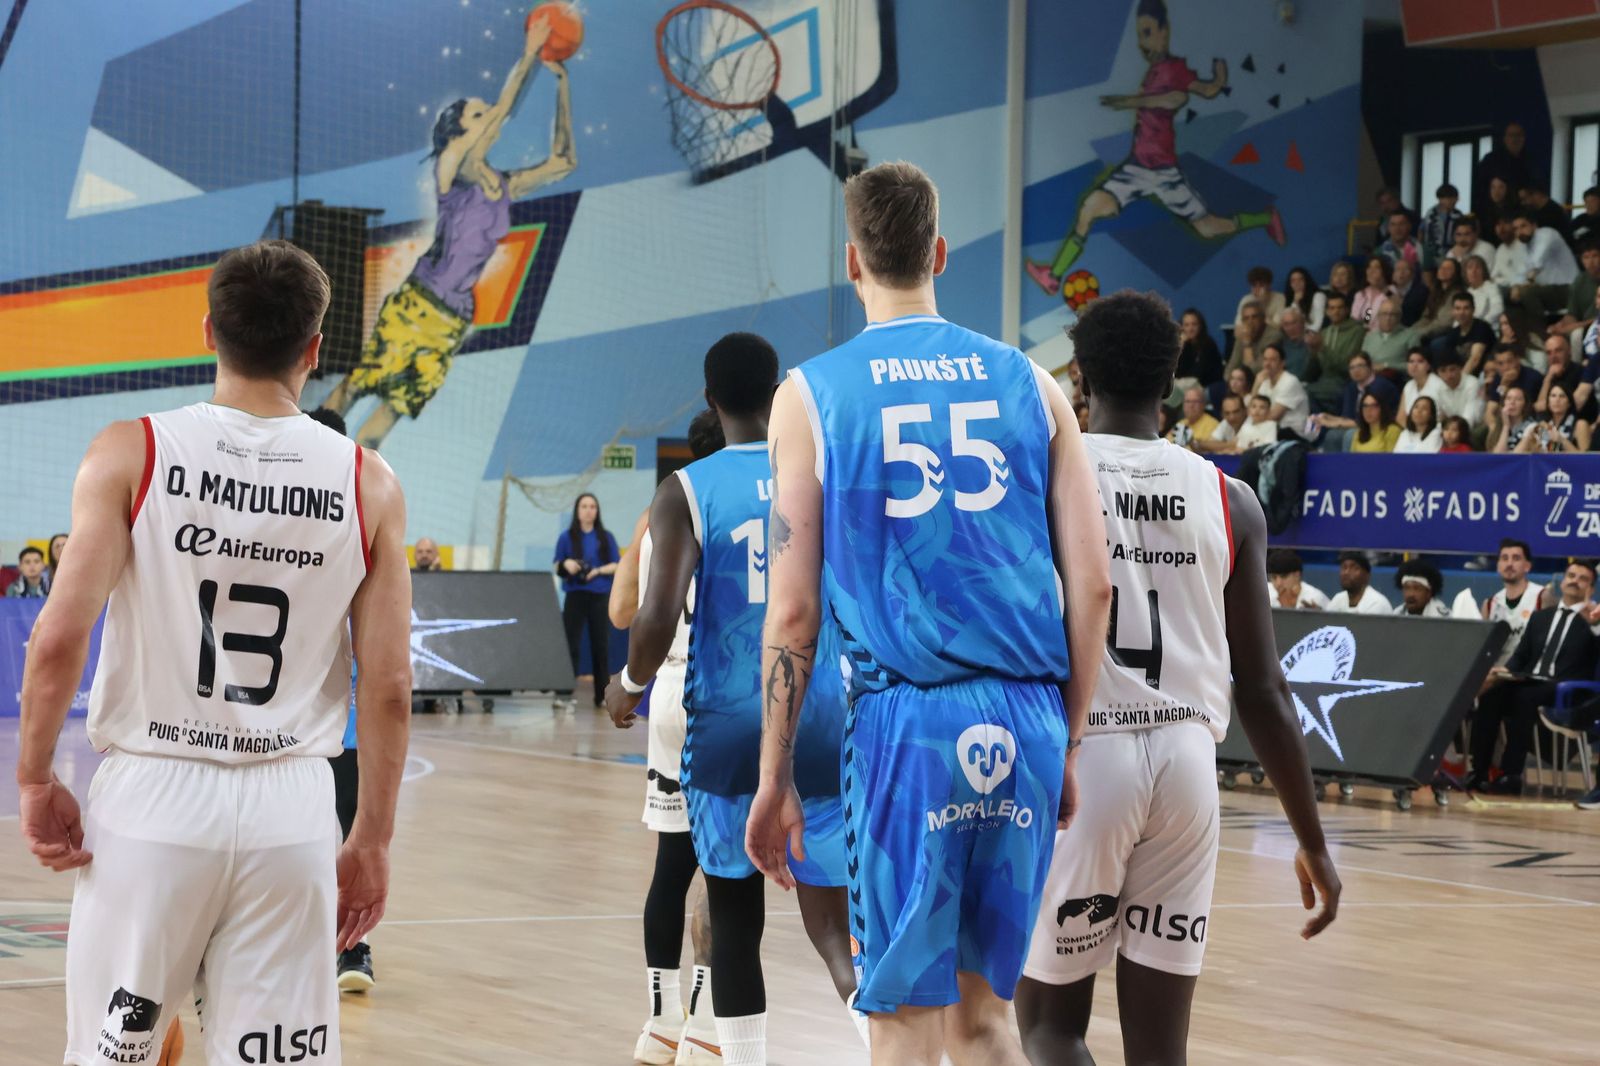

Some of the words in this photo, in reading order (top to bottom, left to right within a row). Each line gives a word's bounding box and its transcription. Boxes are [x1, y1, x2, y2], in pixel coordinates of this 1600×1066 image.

[869, 353, 988, 385] PAUKŠTĖ
[881, 400, 1009, 518] 55
[166, 465, 191, 498] O.
[199, 470, 344, 523] MATULIONIS
[757, 479, 773, 501] L
[1302, 489, 1388, 518] FADIS
[1115, 491, 1186, 521] NIANG
[1427, 491, 1520, 522] FADIS
[217, 537, 325, 569] AirEuropa
[1112, 543, 1196, 568] AirEuropa
[197, 579, 290, 706] 13
[1106, 585, 1163, 690] 4
[1088, 711, 1107, 726] UIG
[1115, 710, 1151, 726] SANTA
[1108, 701, 1176, 710] RESTAURA
[148, 721, 180, 743] PUIG
[187, 729, 229, 750] SANTA
[1125, 904, 1207, 943] alsa
[1056, 945, 1073, 955] EN
[100, 1028, 136, 1051] OMPRAR
[238, 1024, 328, 1064] alsa
[103, 1046, 152, 1064] BALEA
